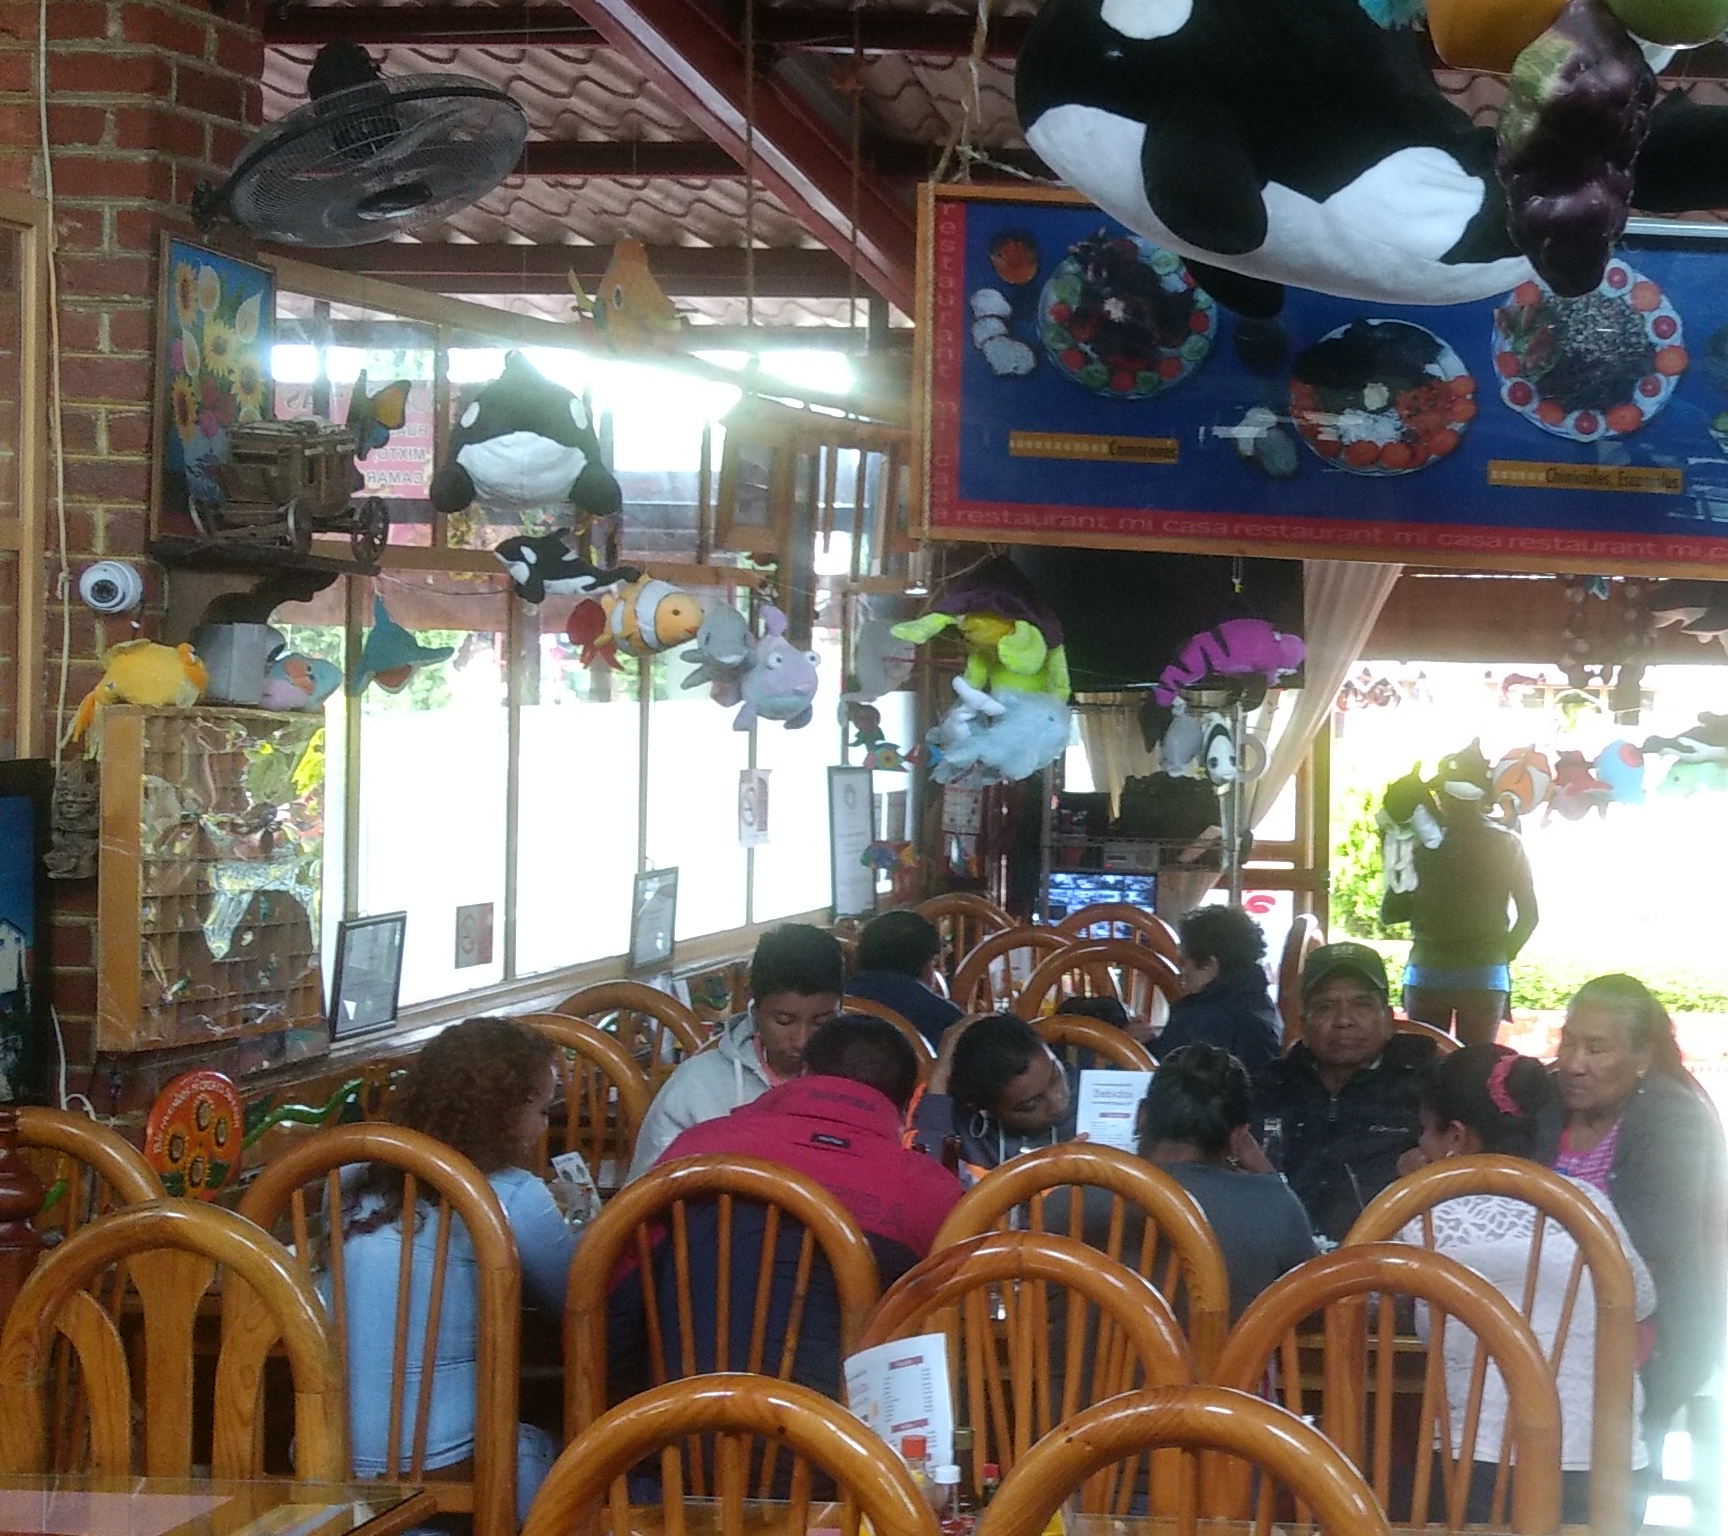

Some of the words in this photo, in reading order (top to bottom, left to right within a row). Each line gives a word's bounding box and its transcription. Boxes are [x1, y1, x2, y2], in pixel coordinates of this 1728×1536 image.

[1109, 440, 1177, 460] Camarones
[956, 507, 1107, 531] restaurant
[1119, 514, 1152, 532] mi
[1163, 518, 1227, 535] casa
[1234, 520, 1381, 542] restaurant
[1398, 528, 1428, 545] mi
[1437, 531, 1501, 548] casa
[1509, 533, 1656, 557] restaurant
